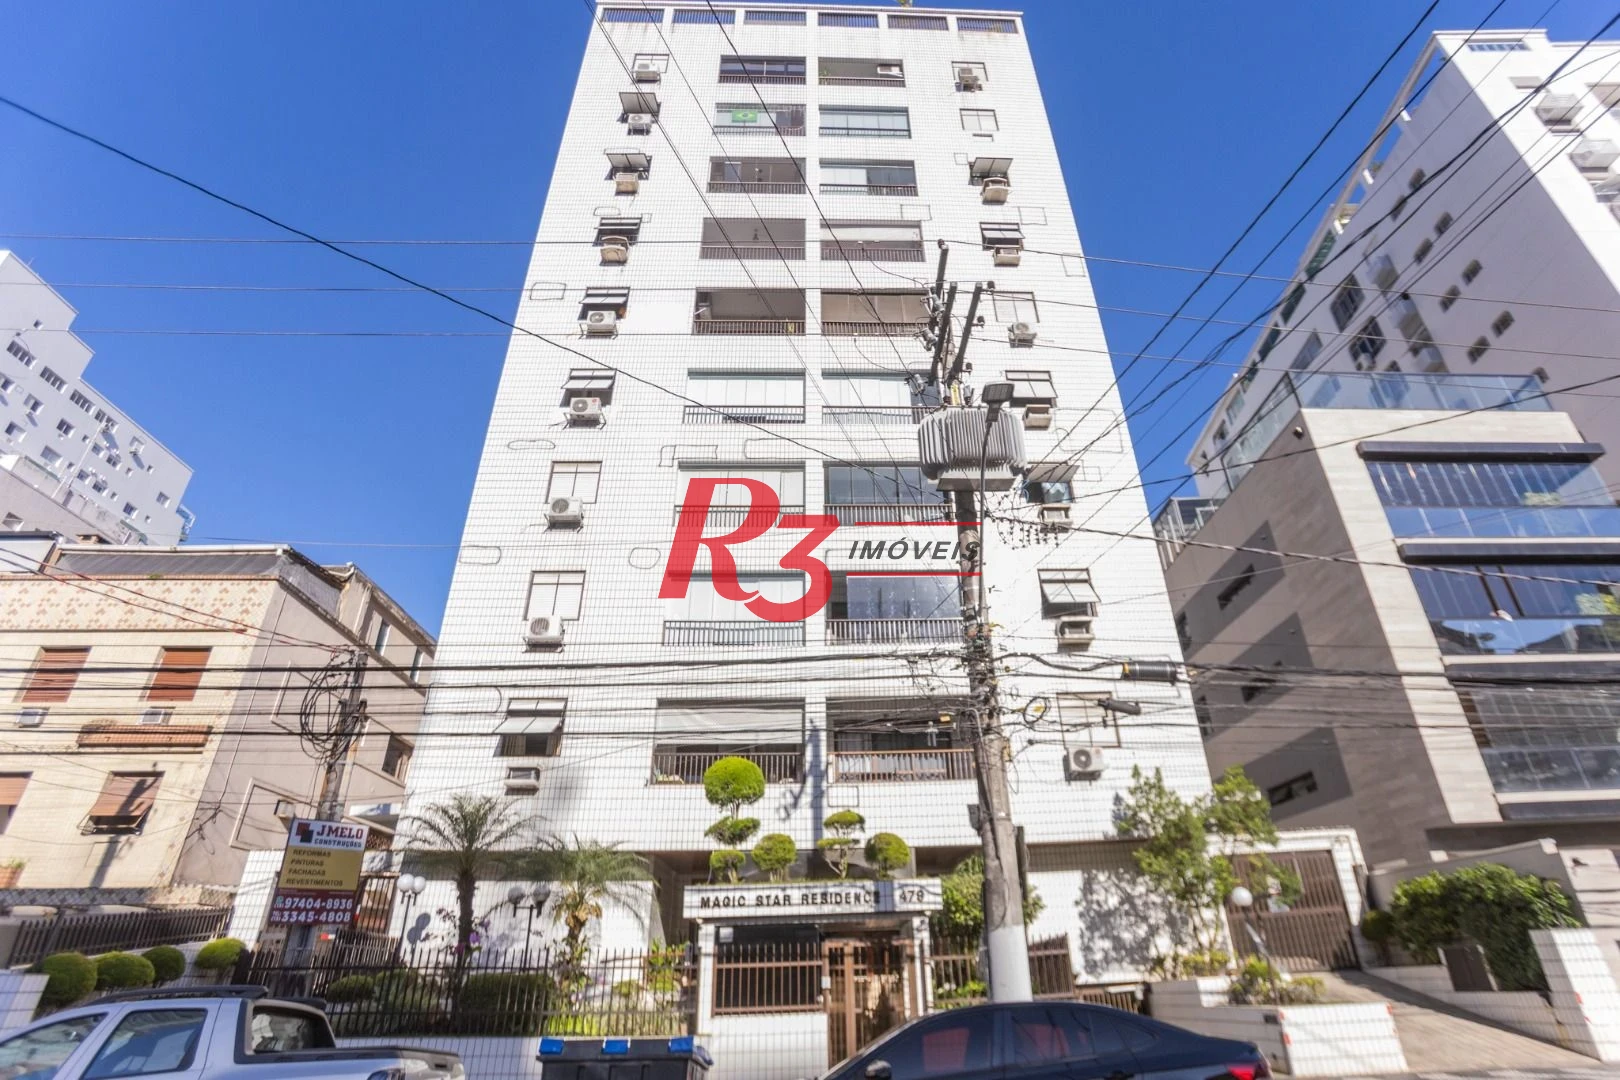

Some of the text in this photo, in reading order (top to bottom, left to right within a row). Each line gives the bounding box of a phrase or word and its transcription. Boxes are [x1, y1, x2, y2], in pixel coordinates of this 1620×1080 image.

[314, 838, 362, 848] CONSTRUÇÕES
[293, 848, 331, 858] REFORMAS
[290, 858, 325, 867] PINTURAS
[288, 868, 326, 876] FACHADAS
[285, 878, 343, 887] REVESTIMENTOS
[284, 897, 353, 910] 97404-8936
[755, 894, 791, 907] STAR
[801, 891, 880, 905] RESIDENCE
[281, 910, 351, 923] 3345-4808
